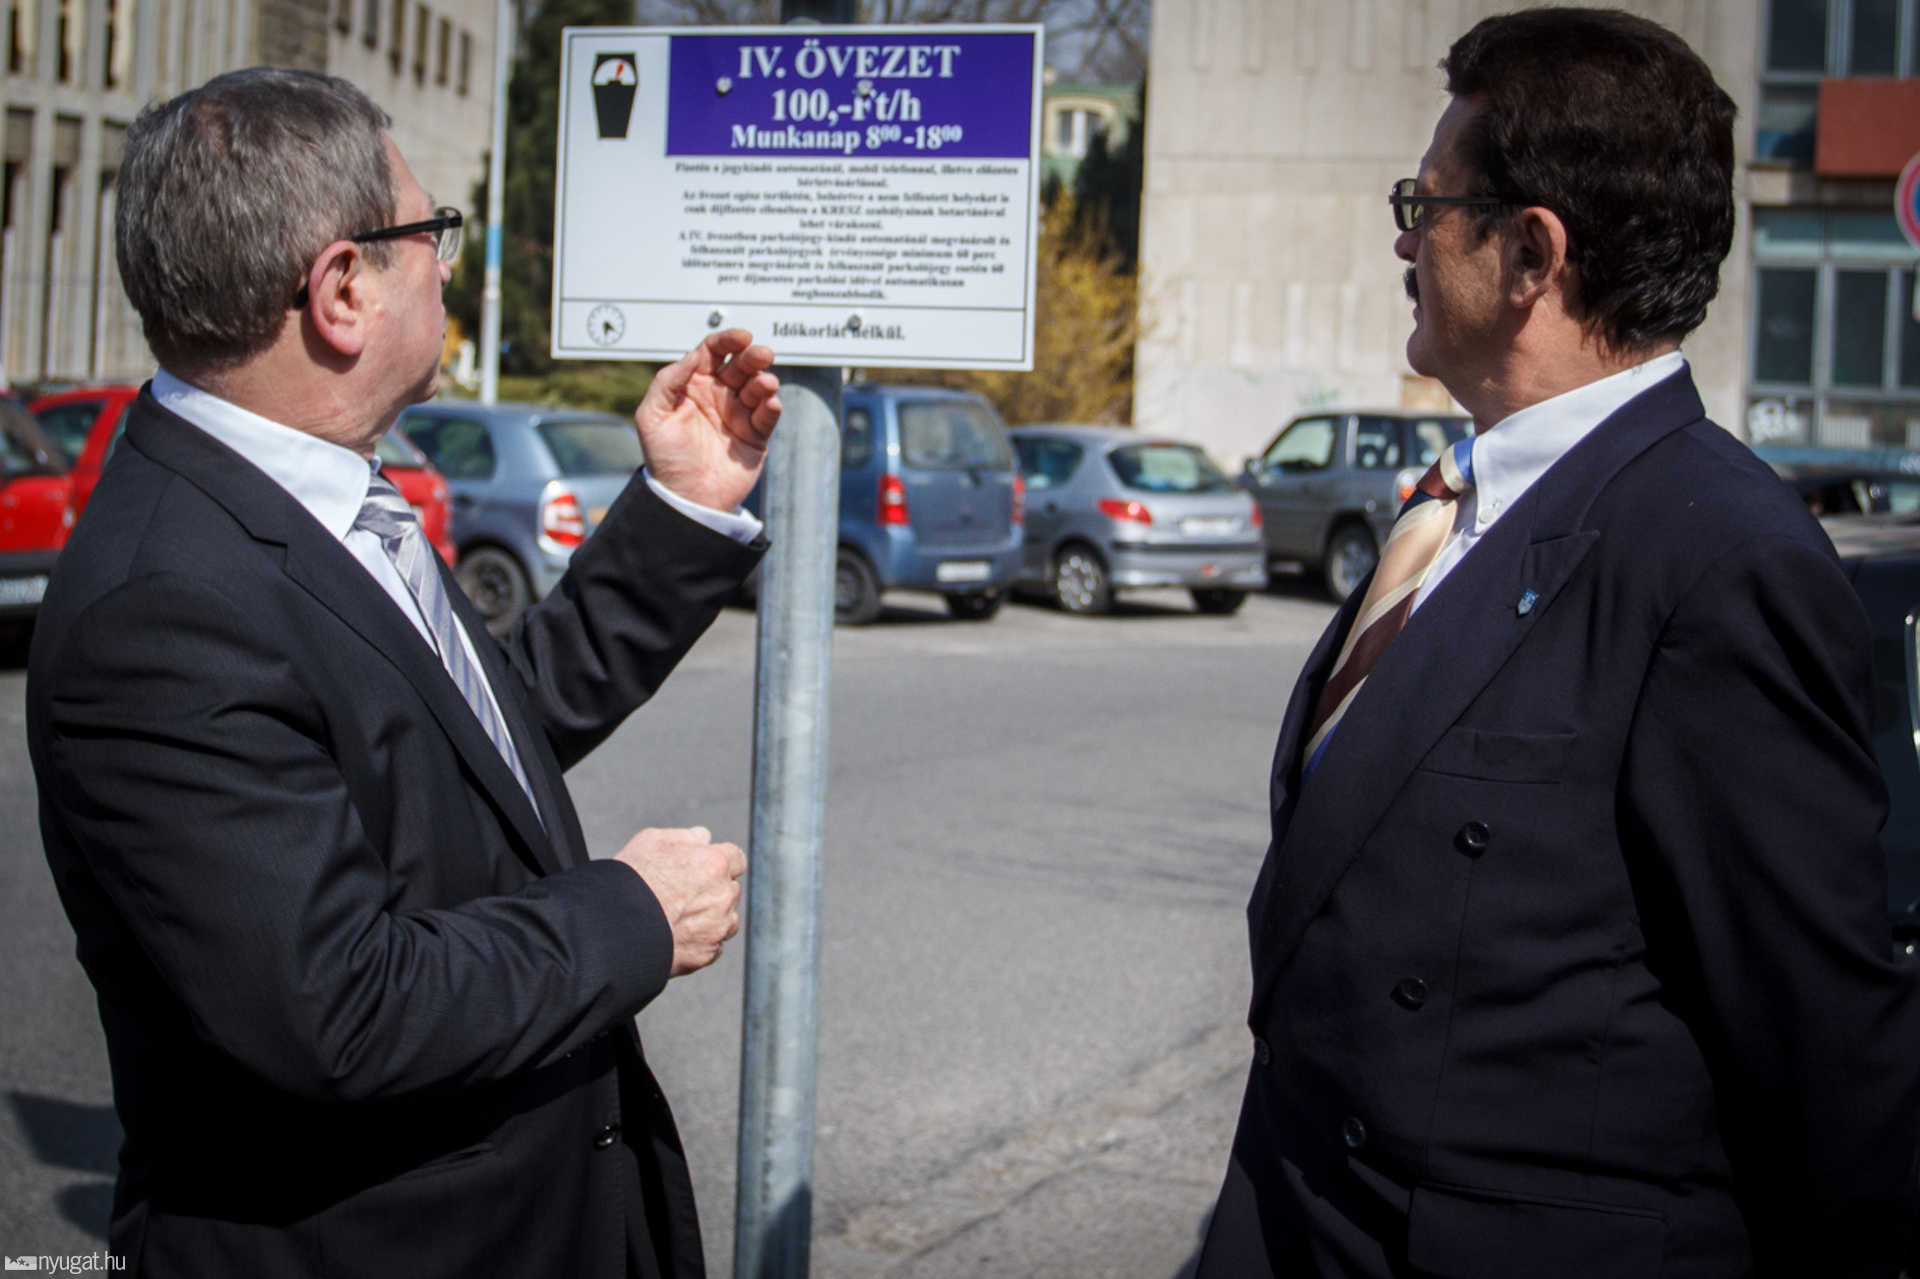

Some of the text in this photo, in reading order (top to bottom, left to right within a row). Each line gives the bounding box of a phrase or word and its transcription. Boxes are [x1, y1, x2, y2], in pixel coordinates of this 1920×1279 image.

[738, 38, 962, 79] IV. ÖVEZET
[731, 124, 862, 155] Munkanap
